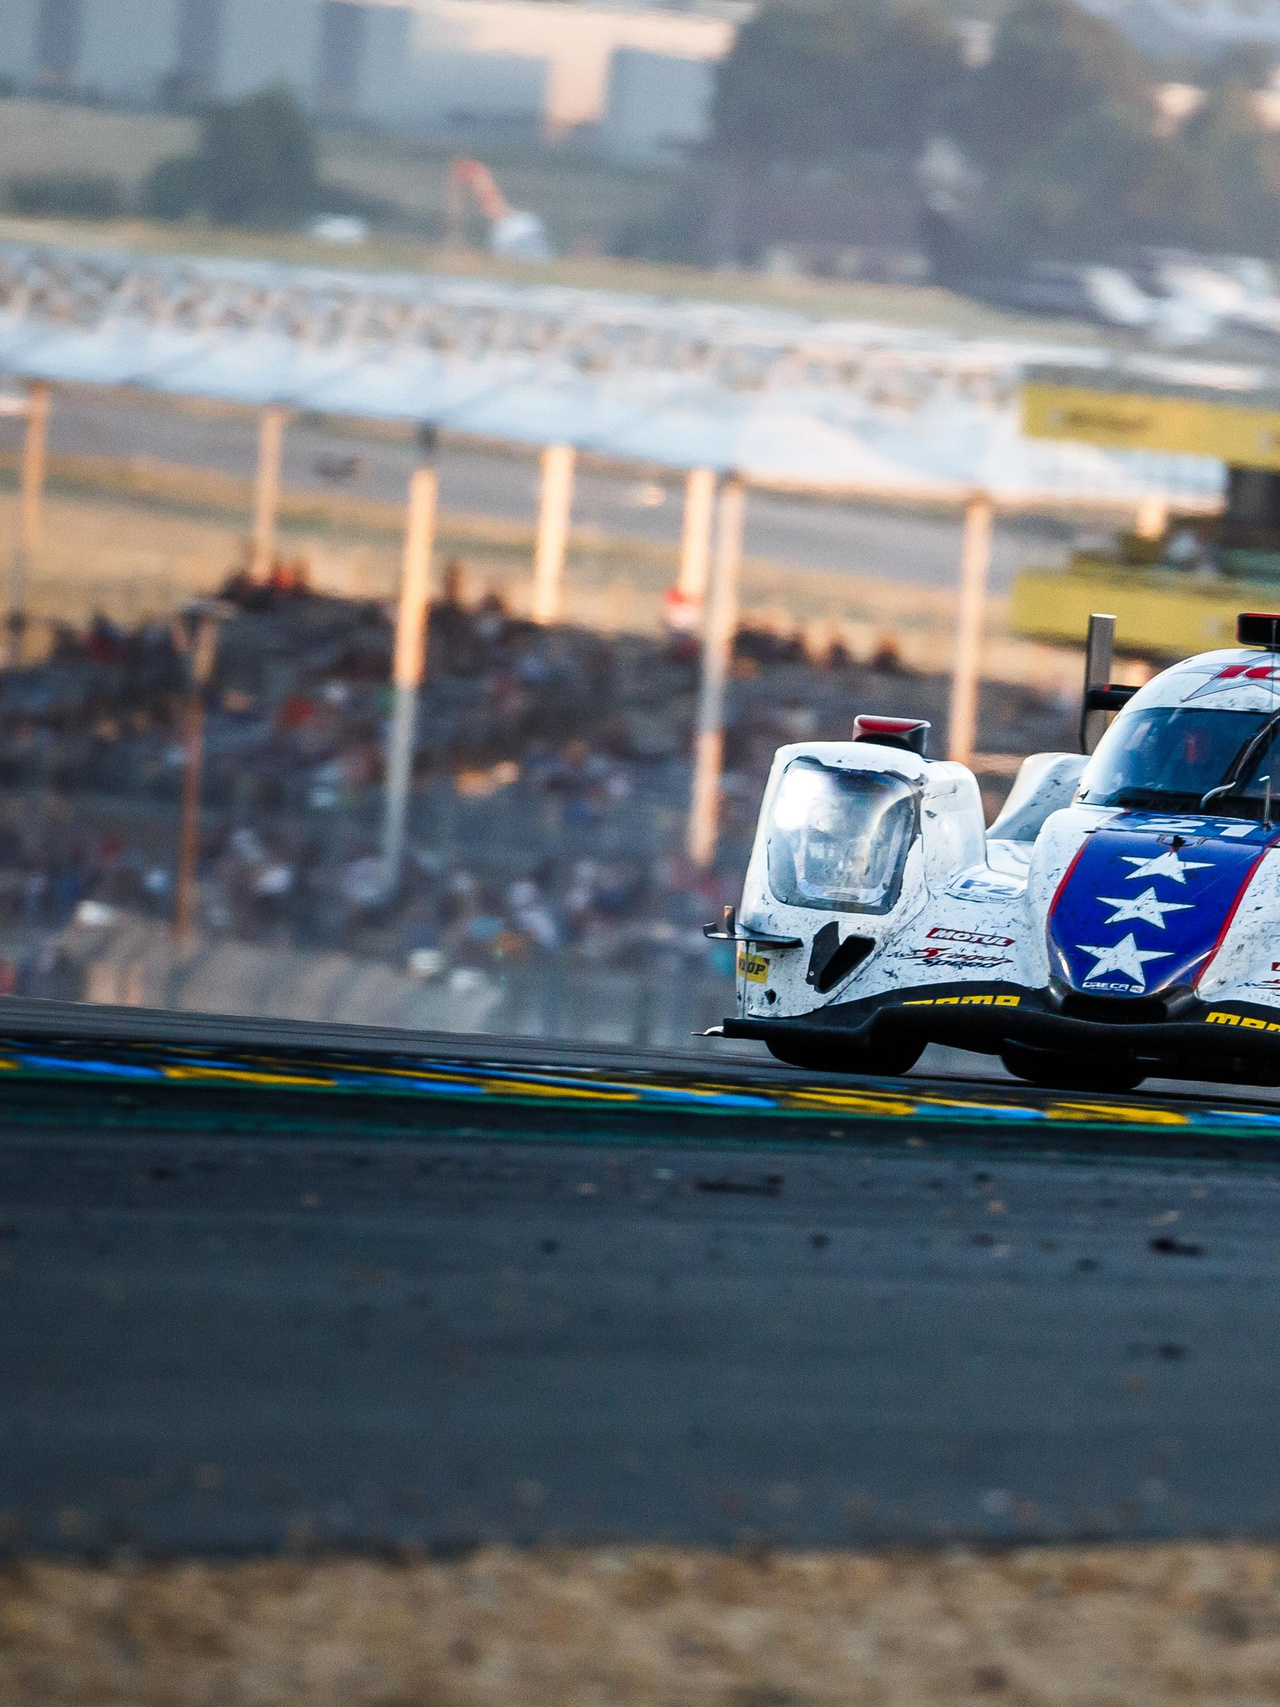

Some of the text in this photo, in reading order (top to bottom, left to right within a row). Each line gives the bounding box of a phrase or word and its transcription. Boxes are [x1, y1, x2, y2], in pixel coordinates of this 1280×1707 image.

[1134, 818, 1259, 838] 21
[958, 878, 1018, 897] P2
[933, 928, 1006, 947] MOTUL
